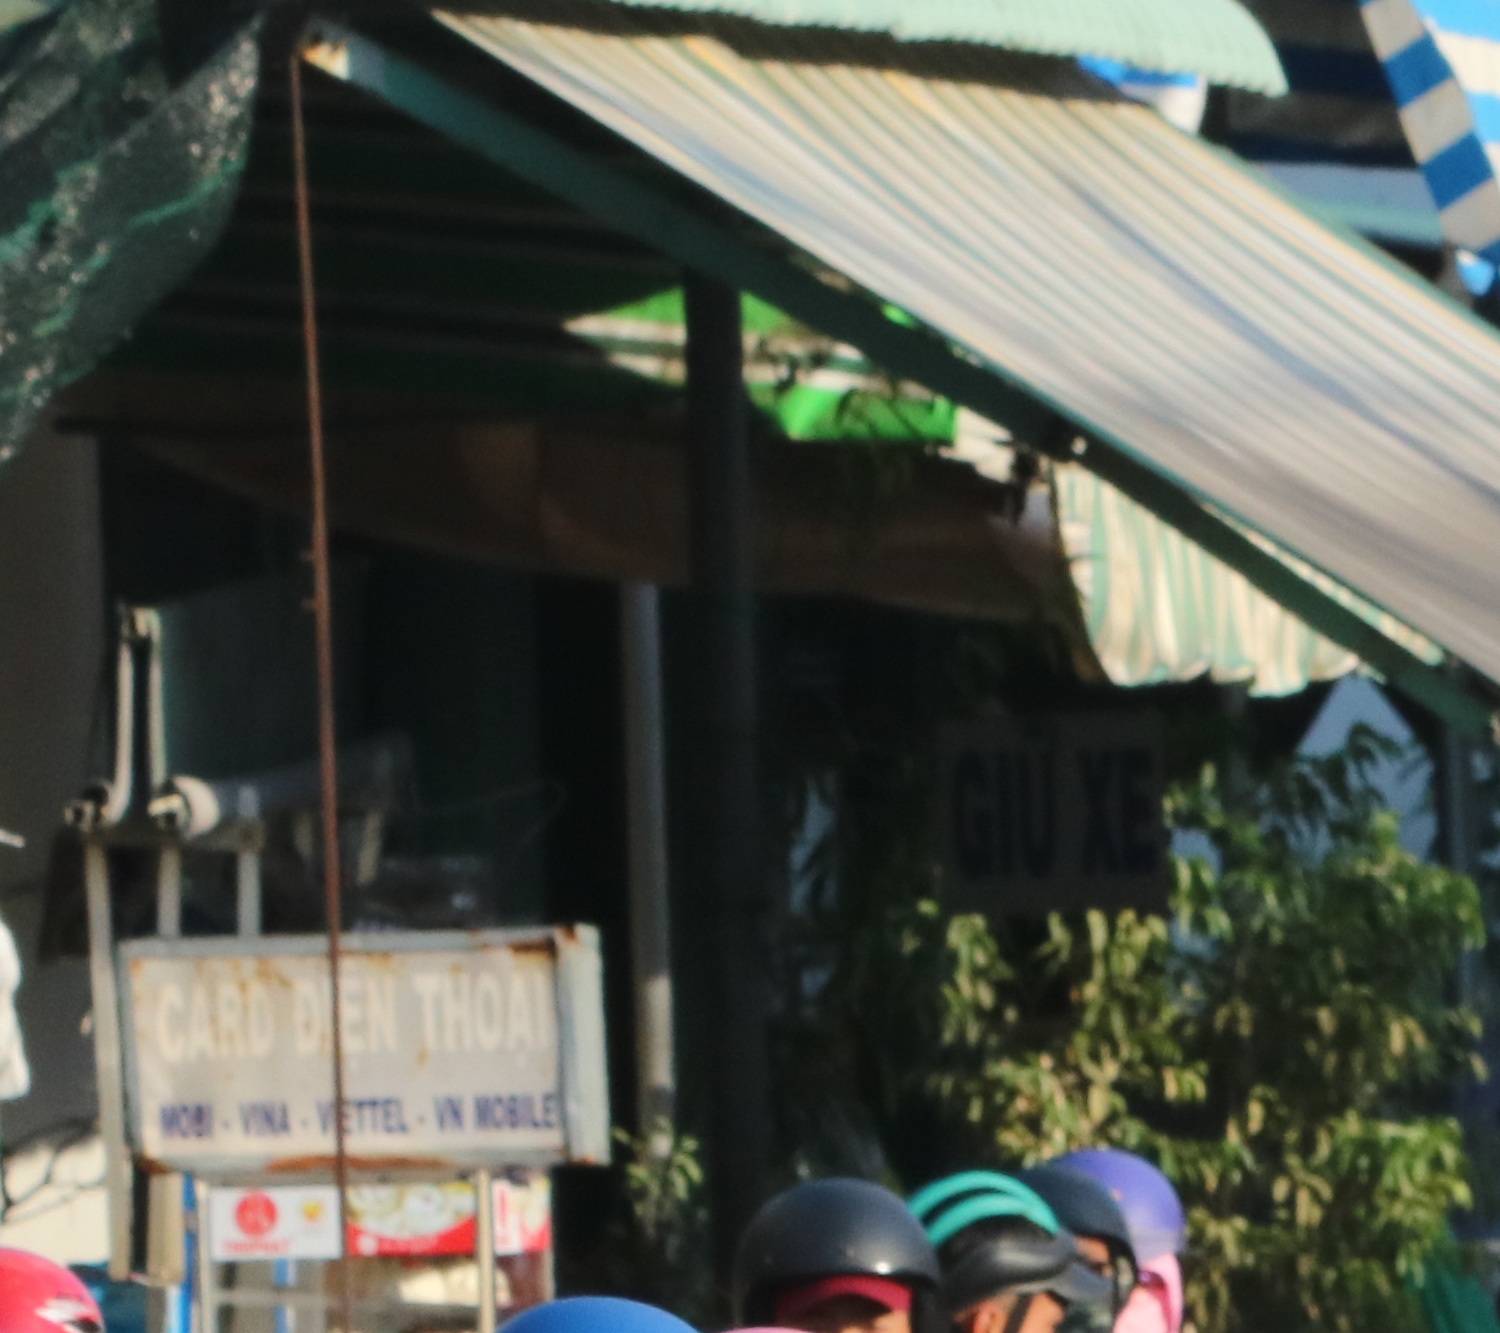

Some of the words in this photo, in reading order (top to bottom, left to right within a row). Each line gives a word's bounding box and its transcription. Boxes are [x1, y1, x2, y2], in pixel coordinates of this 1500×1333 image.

[158, 981, 275, 1062] CARD
[414, 969, 555, 1068] THOẠI
[160, 1103, 215, 1139] MOBI
[240, 1101, 291, 1136] VINA
[433, 1094, 464, 1132] VN
[473, 1093, 557, 1131] MOBILE
